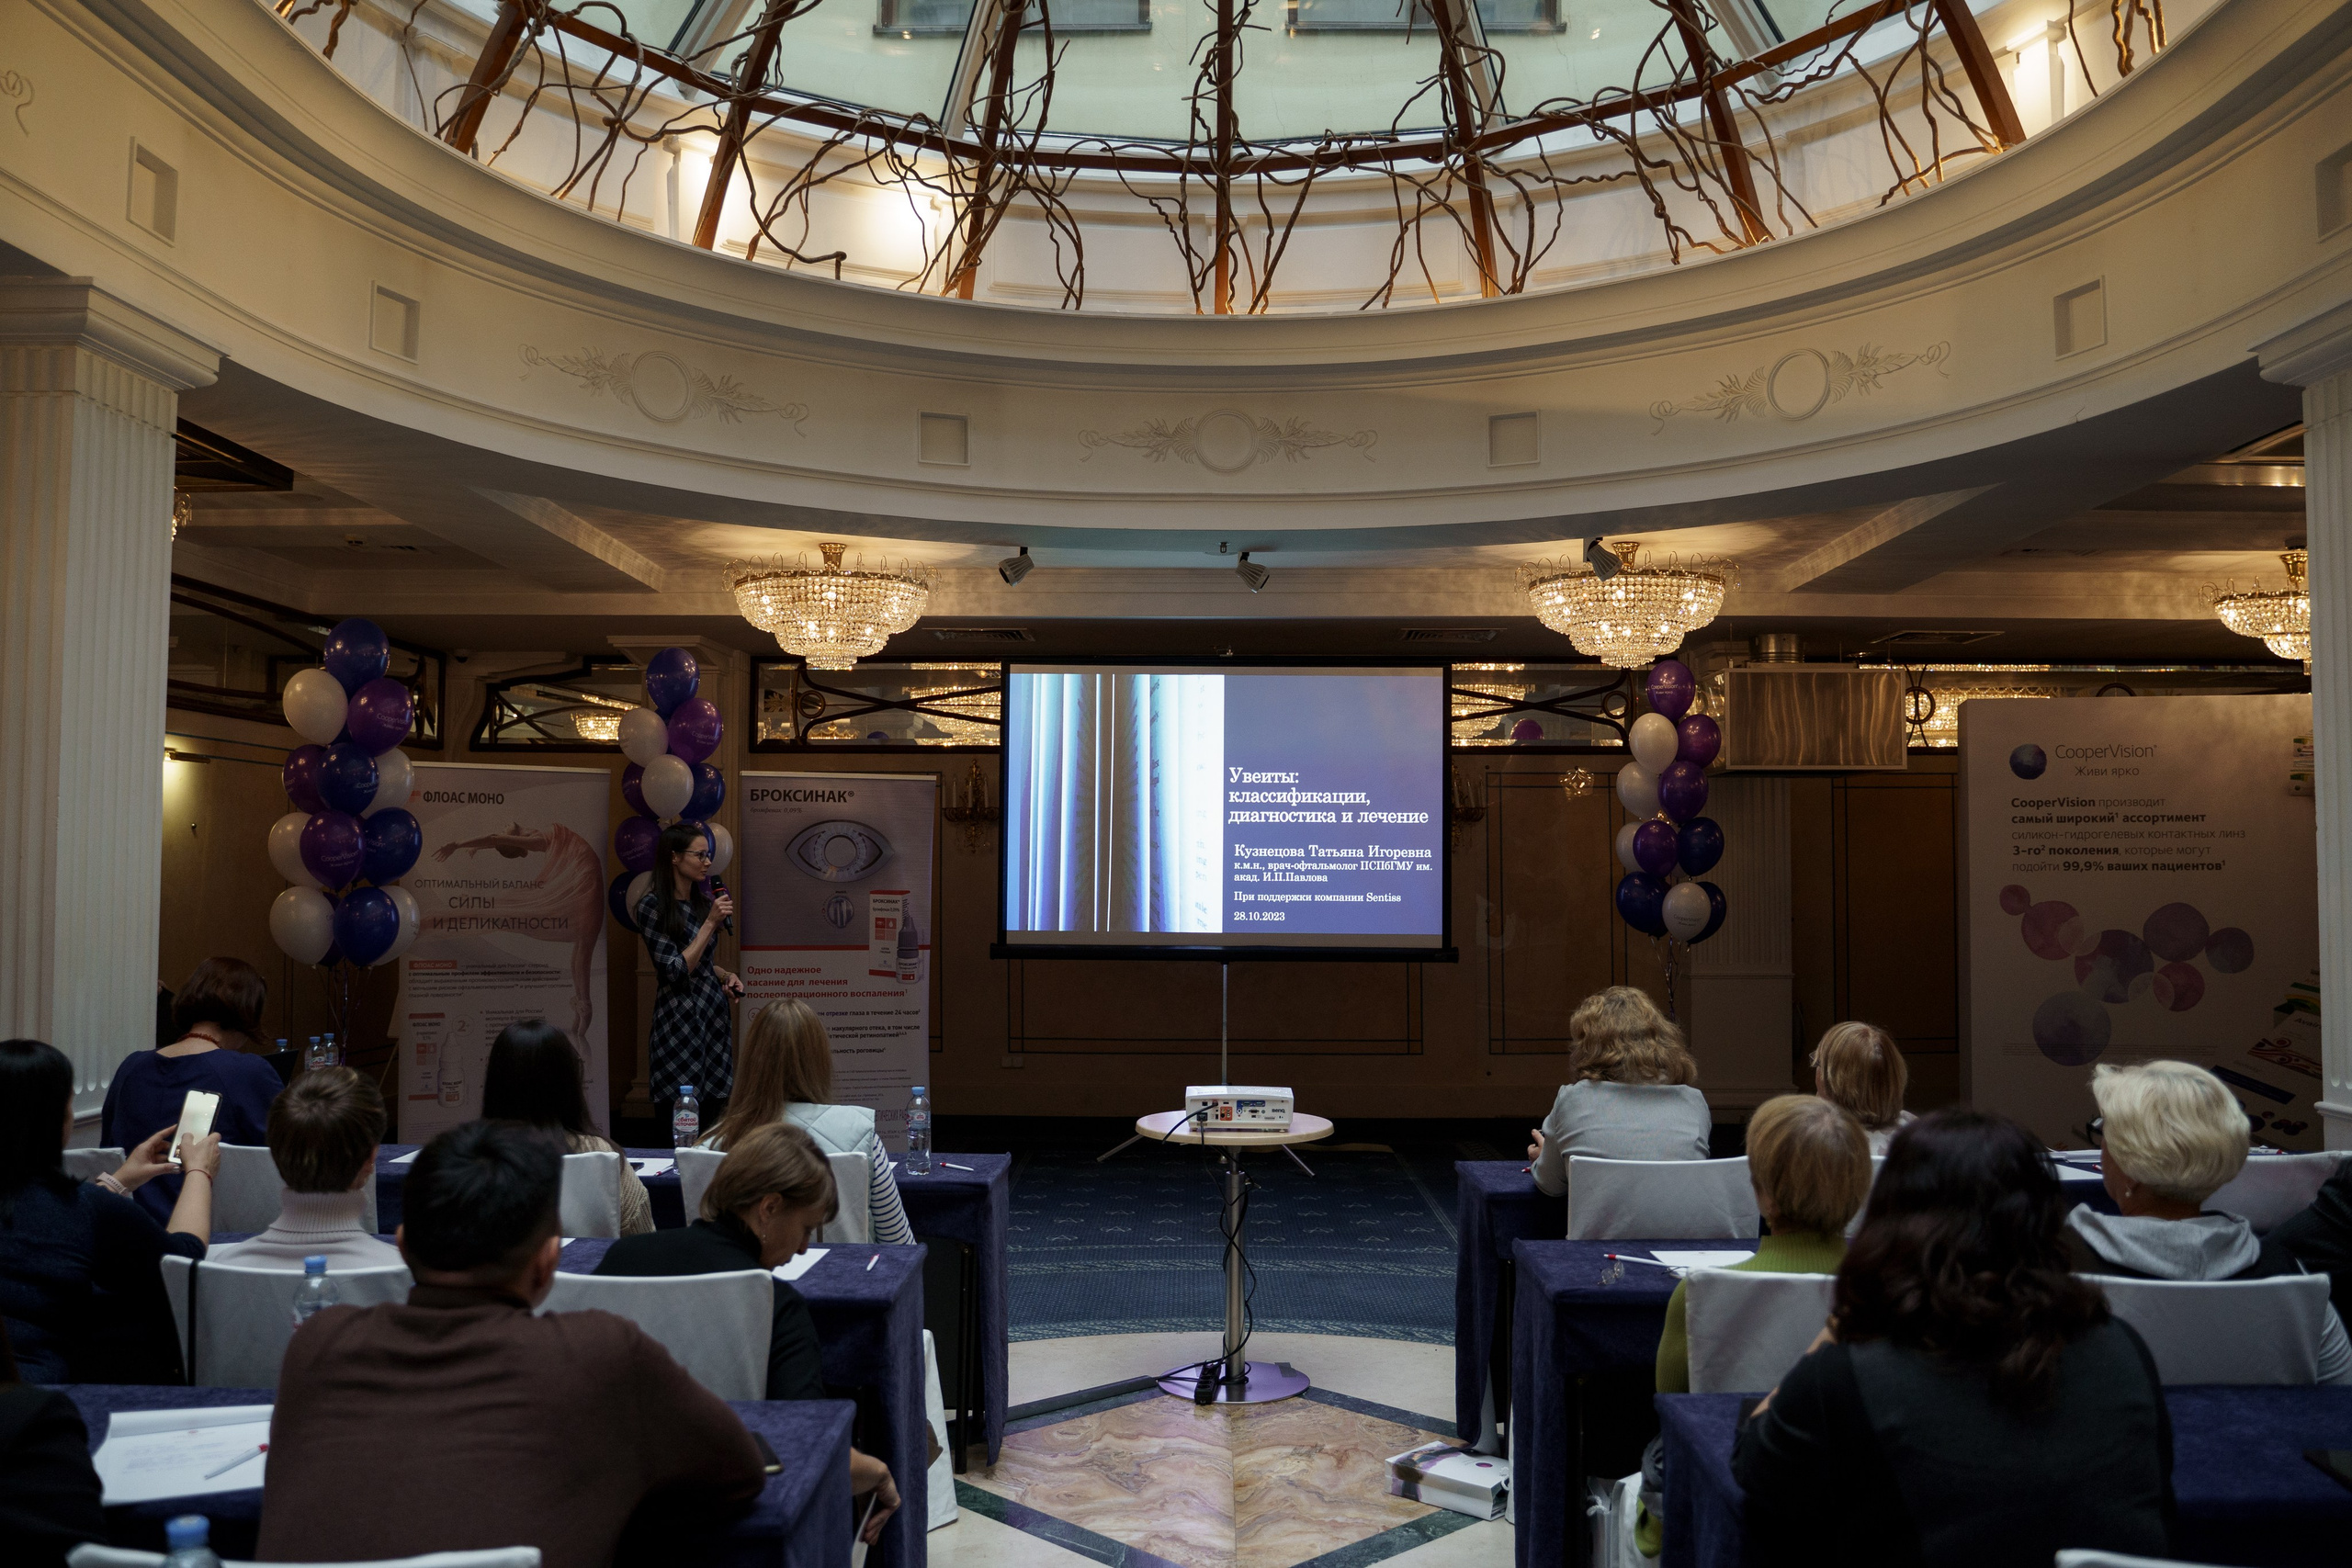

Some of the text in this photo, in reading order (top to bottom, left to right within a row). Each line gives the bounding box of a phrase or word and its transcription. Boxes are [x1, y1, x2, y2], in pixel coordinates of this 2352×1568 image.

[1229, 767, 1299, 784] Увеиты:
[2075, 766, 2140, 778] Живи ярко
[423, 791, 504, 805] ФЛОАС МОНО
[1228, 787, 1371, 806] классификации,
[2011, 797, 2165, 810] CooperVision производит
[1228, 810, 1429, 825] диагностика и лечение
[2011, 813, 2053, 824] самый
[2122, 814, 2206, 825] ассортимент
[2011, 829, 2246, 841] силикон-гидрогелевых контактных линз
[1234, 844, 1432, 859] Кузнецова Татьяна Игоревна
[2049, 847, 2121, 857] поколения,
[2124, 846, 2174, 857] которые
[2176, 846, 2211, 857] могут
[1234, 861, 1433, 871] к.м.н., врач-офтальмолог ПСПбГМУ им.
[2012, 863, 2060, 874] подойти
[2063, 861, 2104, 873] 99,9%
[2107, 863, 2148, 872] ваших
[414, 878, 545, 889] ОПТИМАЛЬНЫЙ БАЛАНС
[1234, 872, 1328, 883] акад. И.П.Павлова
[448, 897, 495, 909] СИЛЫ
[1234, 891, 1401, 903] При поддержки компании Sentiss
[1234, 911, 1285, 921] 28.10.2023
[434, 918, 443, 930] И
[447, 918, 569, 931] ДЕЛИКАТНОСТИ
[747, 966, 773, 976] Одно
[786, 979, 805, 987] для
[747, 990, 848, 999] послеоперационного
